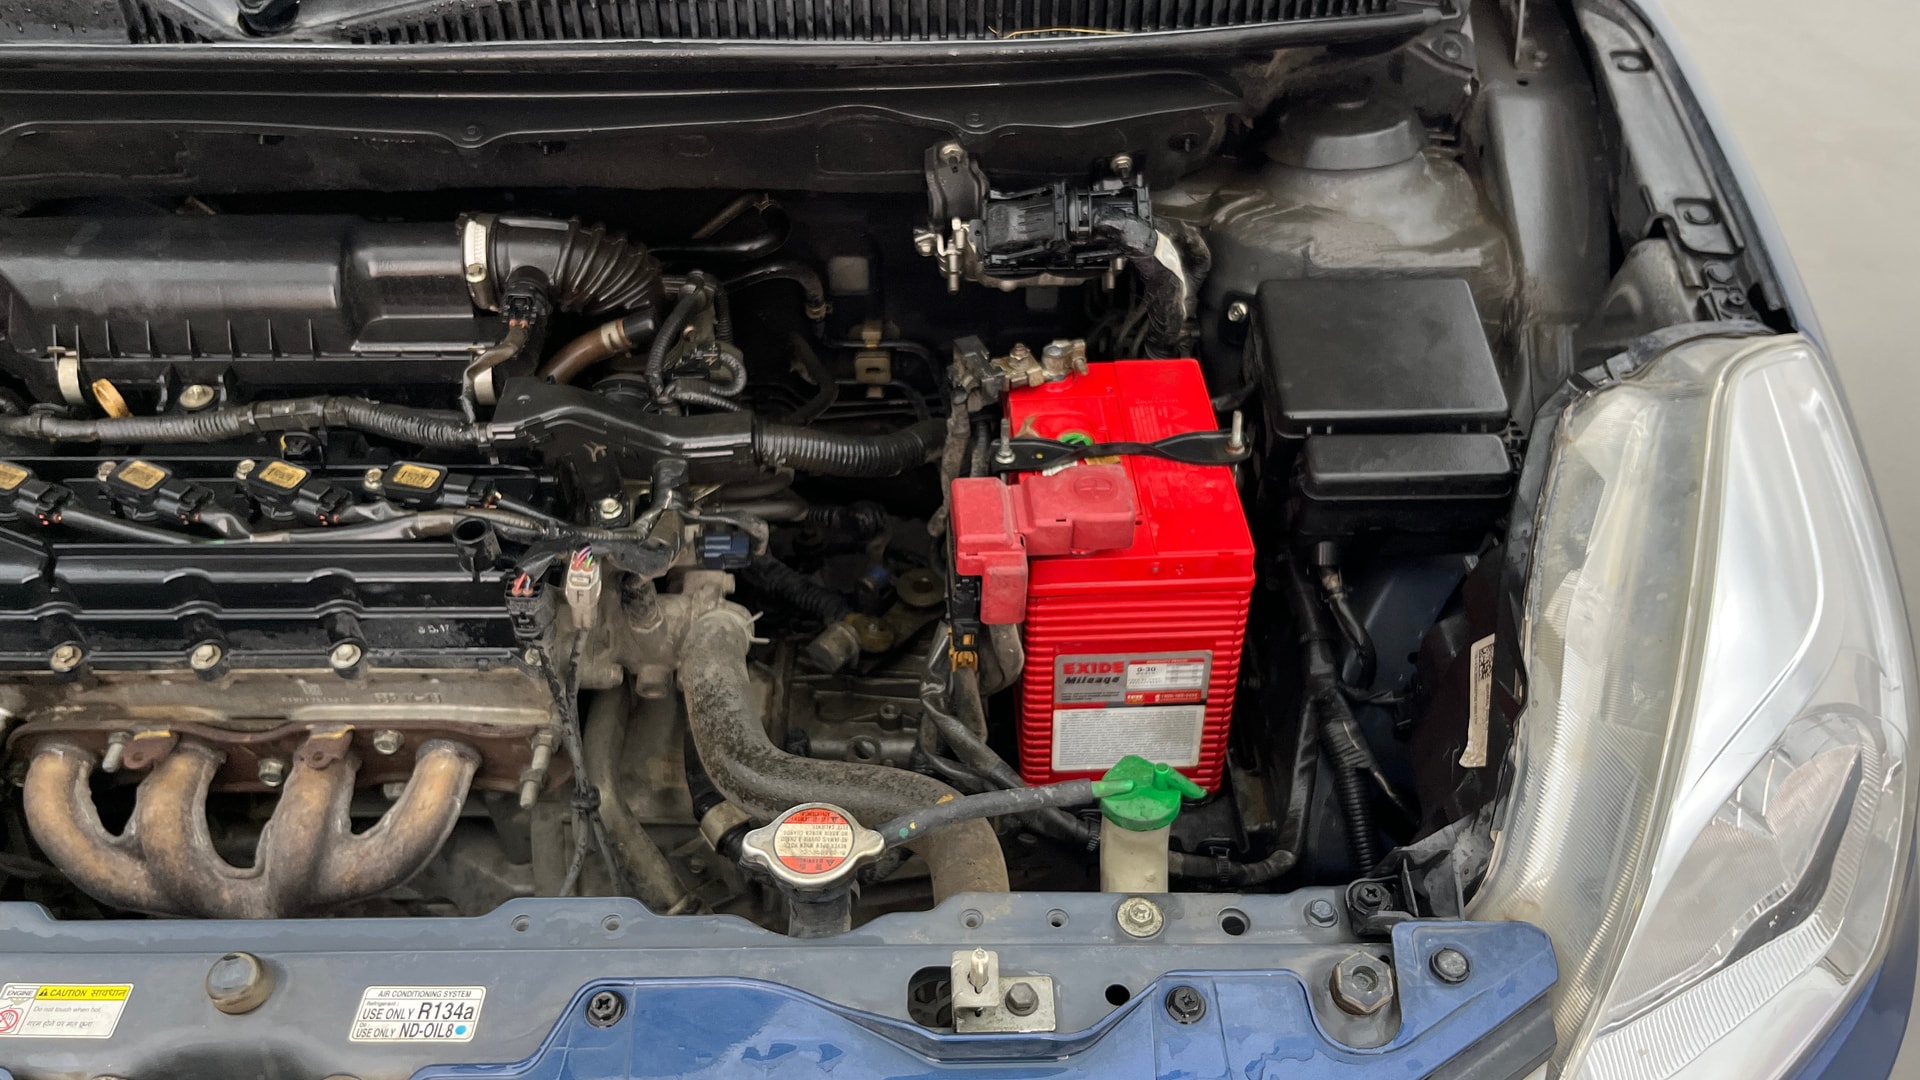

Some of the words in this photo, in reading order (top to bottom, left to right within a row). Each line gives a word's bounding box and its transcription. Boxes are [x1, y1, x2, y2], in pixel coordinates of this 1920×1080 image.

[1063, 661, 1125, 674] EXIDE
[1064, 676, 1121, 684] Mileage
[50, 989, 87, 997] CAUTION
[377, 990, 391, 998] AIR
[391, 990, 442, 998] CONDITIONING
[443, 990, 472, 998] SYSTEM
[362, 1008, 383, 1020] USE
[385, 1008, 415, 1020] ONLY
[417, 1002, 475, 1020] R134a
[356, 1028, 372, 1038] USE
[373, 1028, 396, 1038] ONLY
[399, 1023, 455, 1038] ND-OIL8
